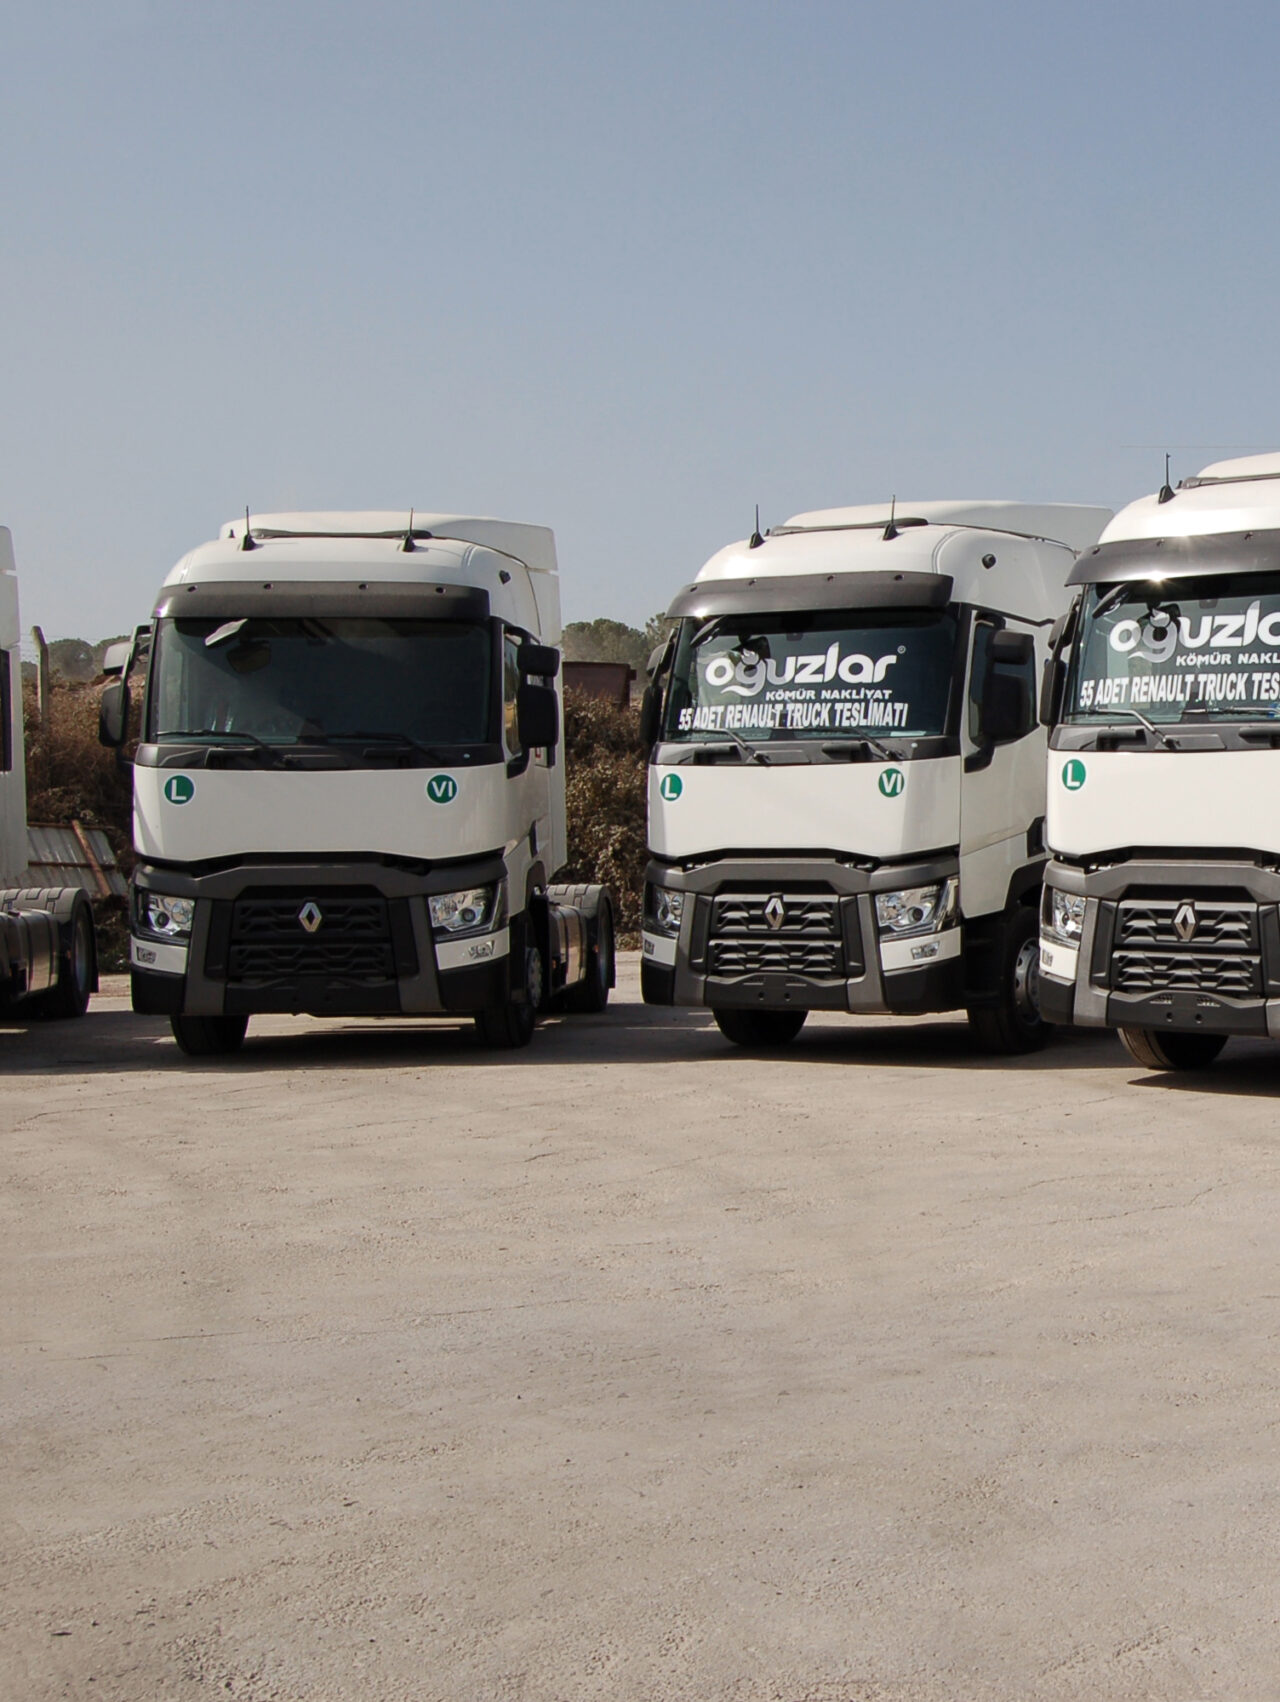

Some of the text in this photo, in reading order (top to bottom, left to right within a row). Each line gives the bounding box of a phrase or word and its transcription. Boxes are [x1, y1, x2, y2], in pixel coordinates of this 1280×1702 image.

[1176, 651, 1231, 667] KÖMÜR
[766, 687, 892, 701] KÖMÜR NAKLİYAT
[1080, 680, 1095, 707] 55
[1095, 677, 1129, 704] ADET
[1130, 674, 1194, 702] RENAULT
[1198, 672, 1248, 700] TRUCK
[693, 704, 724, 729] ADET
[725, 702, 786, 728] RENAULT
[786, 702, 830, 727] TRUCK
[834, 698, 908, 727] TESLİMATI
[882, 773, 902, 794] VI
[1066, 763, 1080, 787] L
[171, 780, 187, 801] L
[432, 780, 455, 798] VI
[664, 777, 678, 798] L
